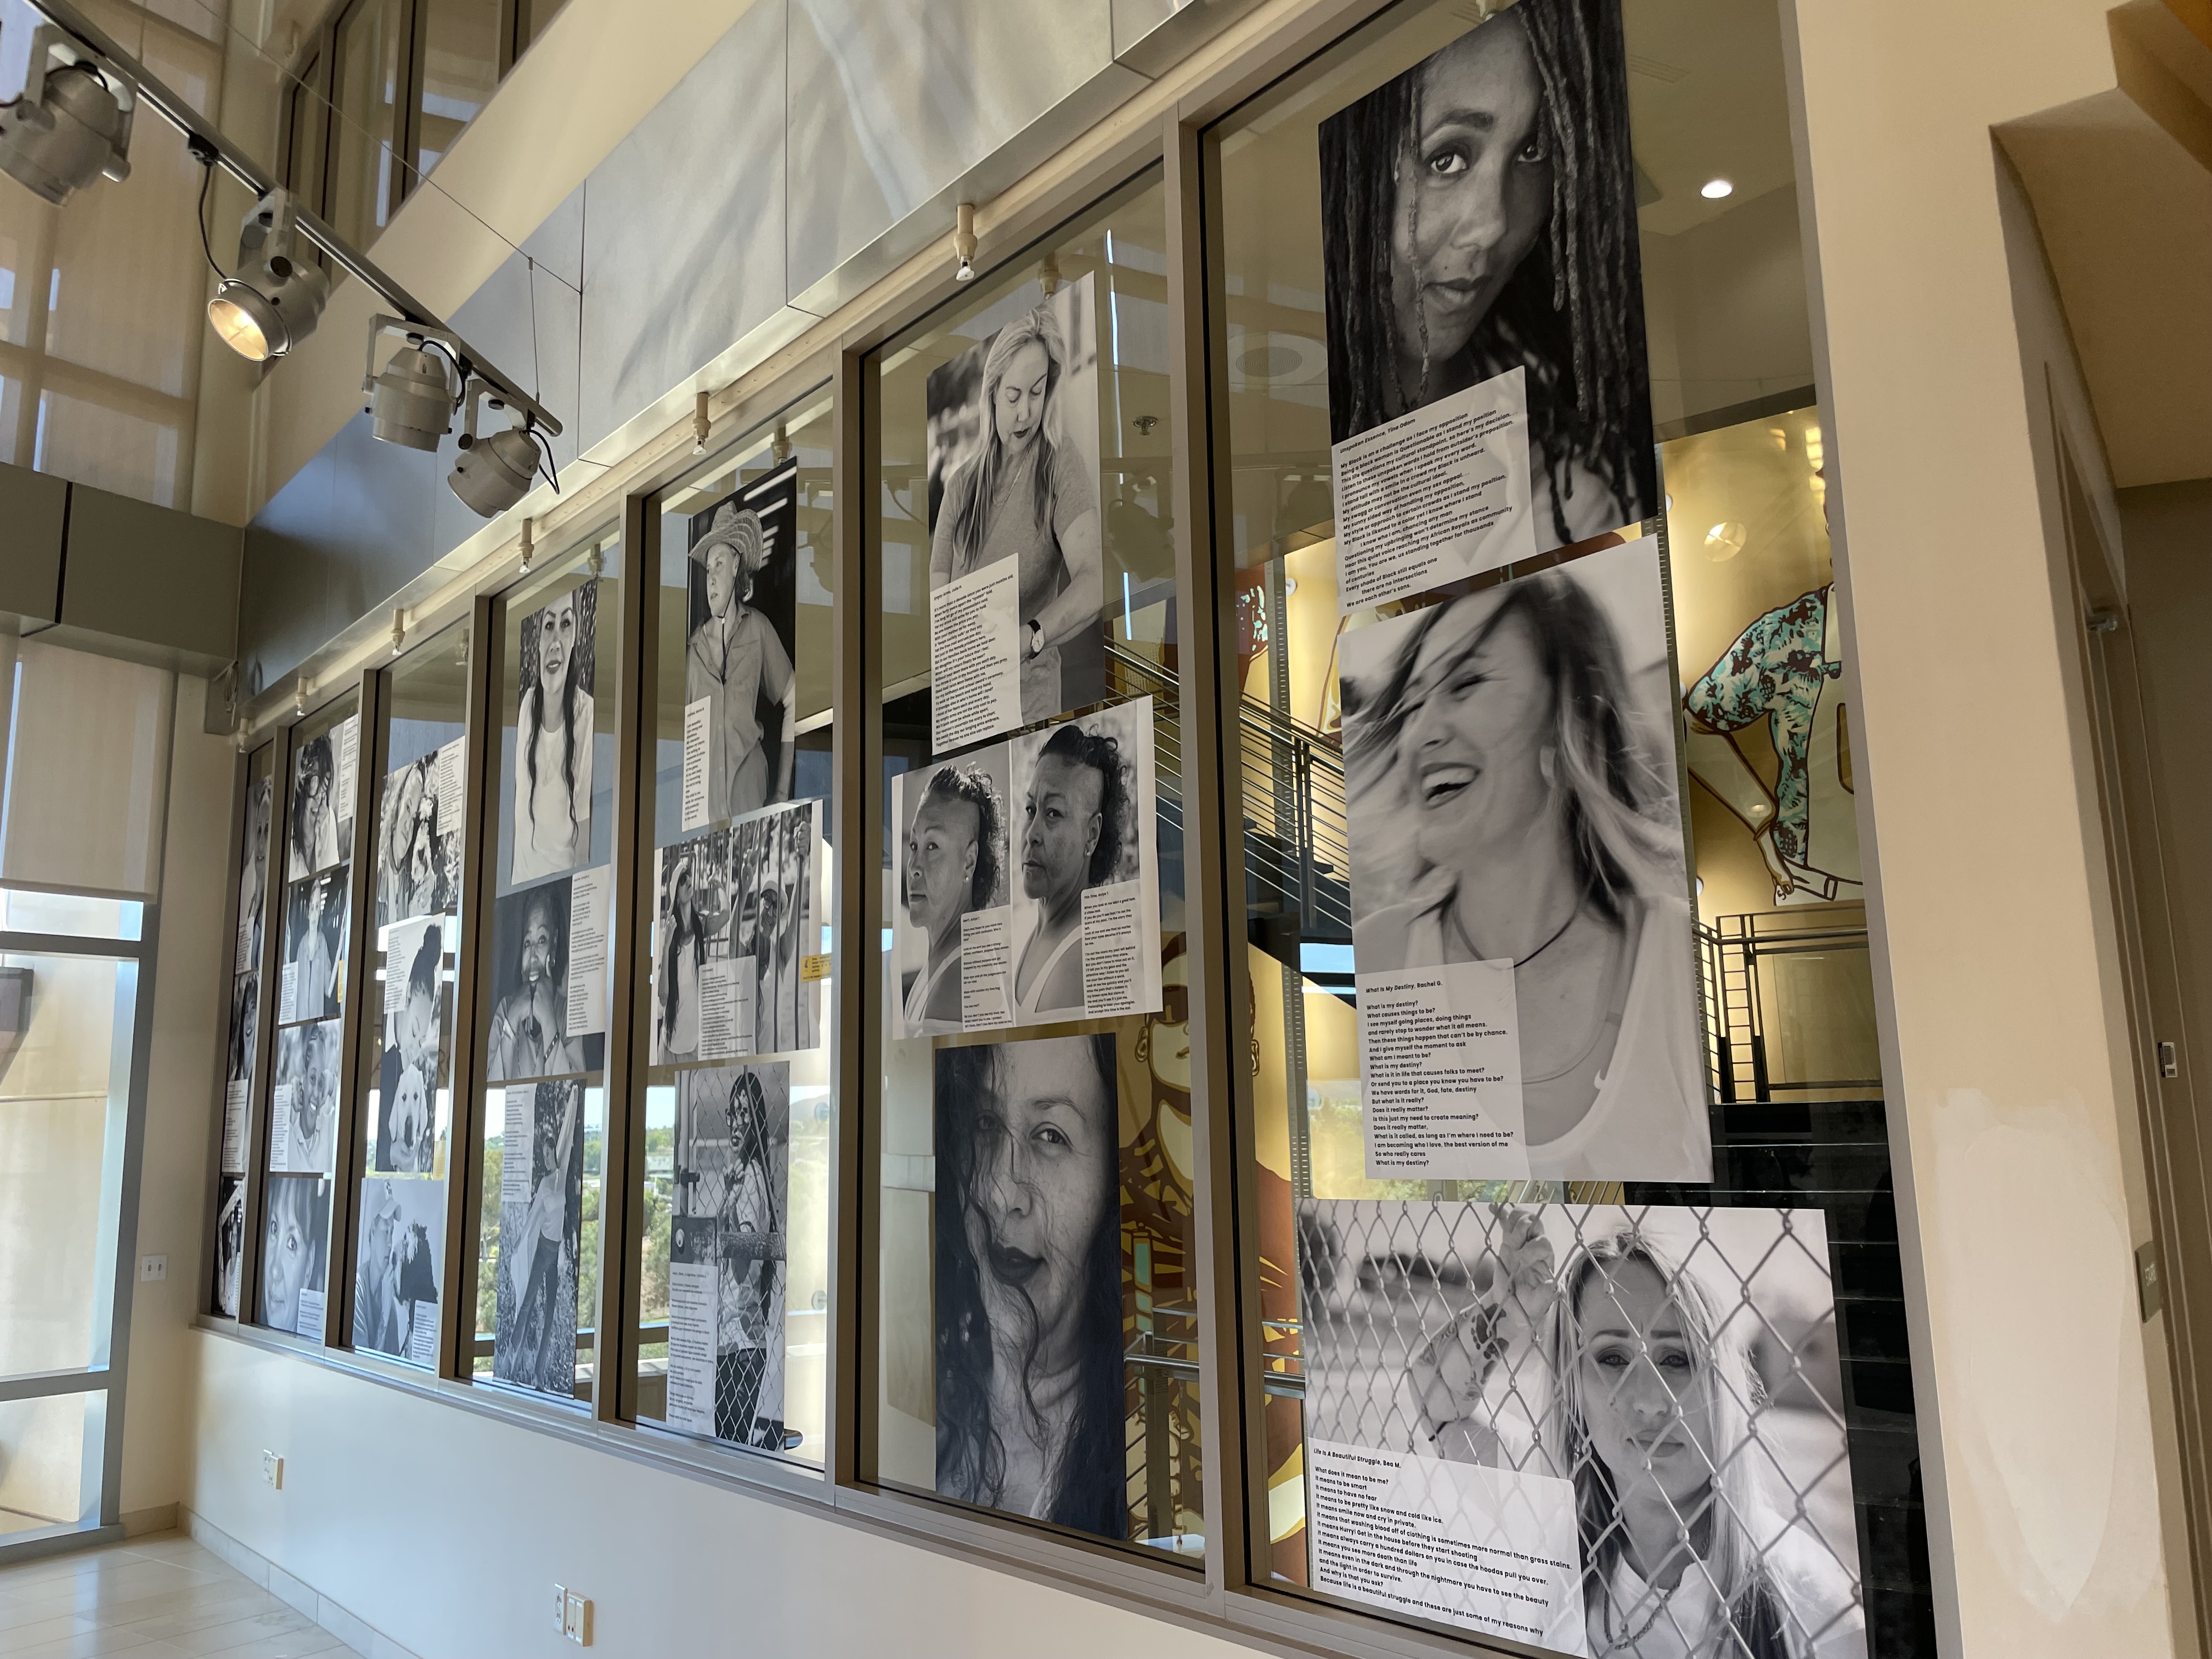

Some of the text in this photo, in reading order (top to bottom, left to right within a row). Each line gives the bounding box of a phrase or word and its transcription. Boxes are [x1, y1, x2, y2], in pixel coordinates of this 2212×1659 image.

[1340, 440, 1363, 453] Unspoken
[1350, 500, 1370, 511] attitude
[1410, 476, 1431, 488] cultural
[1432, 470, 1447, 479] ideal.
[1346, 584, 1359, 592] Every
[1360, 578, 1375, 587] shade
[1382, 571, 1396, 579] Black
[1408, 561, 1426, 570] equals
[1392, 569, 1427, 584] intersections
[1379, 1019, 1397, 1027] myself
[1332, 1452, 1356, 1460] Beautiful
[1352, 1502, 1368, 1510] pretty
[1330, 1570, 1341, 1578] why
